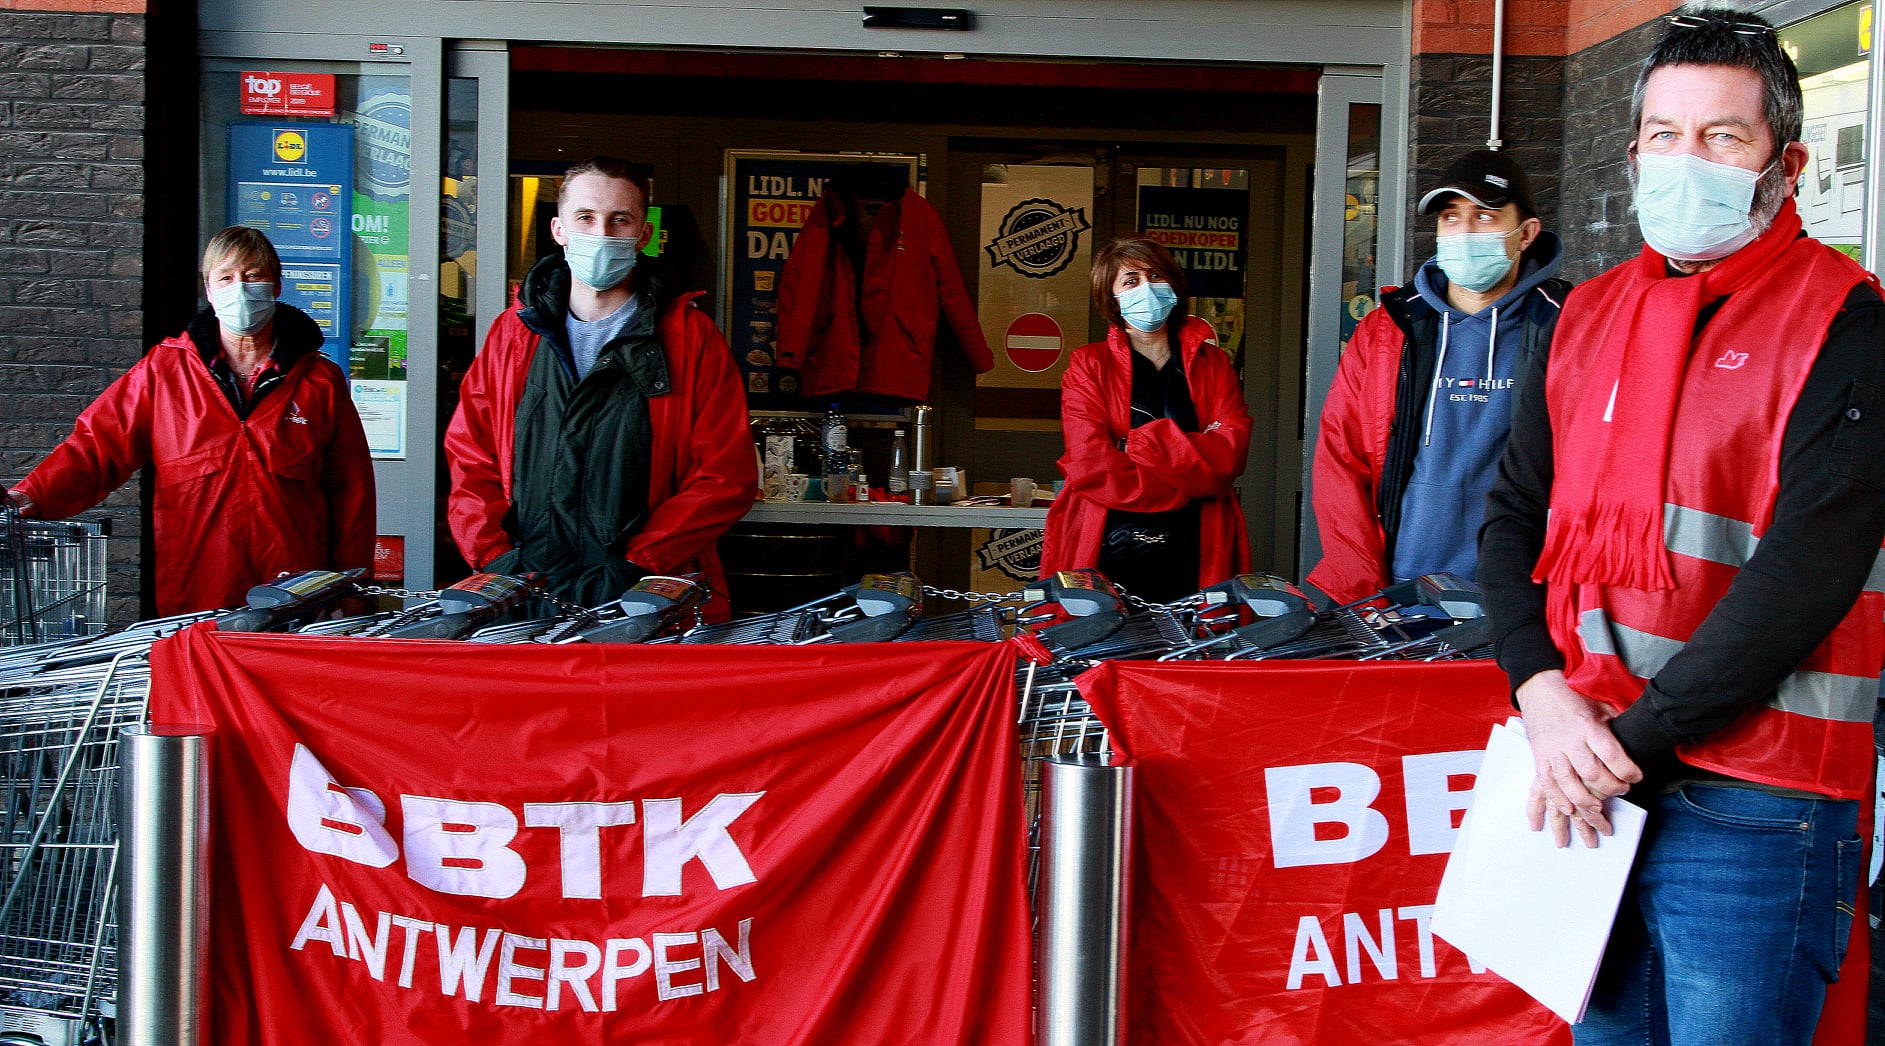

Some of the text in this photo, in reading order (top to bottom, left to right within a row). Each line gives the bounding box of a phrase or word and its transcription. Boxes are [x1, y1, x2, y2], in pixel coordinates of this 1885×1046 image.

[244, 75, 282, 98] top
[262, 167, 318, 178] www.lidl.be
[748, 175, 831, 197] LIDL. N
[1183, 215, 1205, 229] NU
[1207, 216, 1240, 230] NOG
[746, 231, 801, 260] DA
[1006, 219, 1065, 250] PERMANENT
[1015, 233, 1067, 261] VERLAAGD
[1193, 251, 1239, 271] LIDL
[996, 530, 1045, 553] PERMANE
[1006, 541, 1044, 565] VERLAA
[289, 882, 758, 1013] ANTWERPEN
[1284, 903, 1489, 992] ANT
